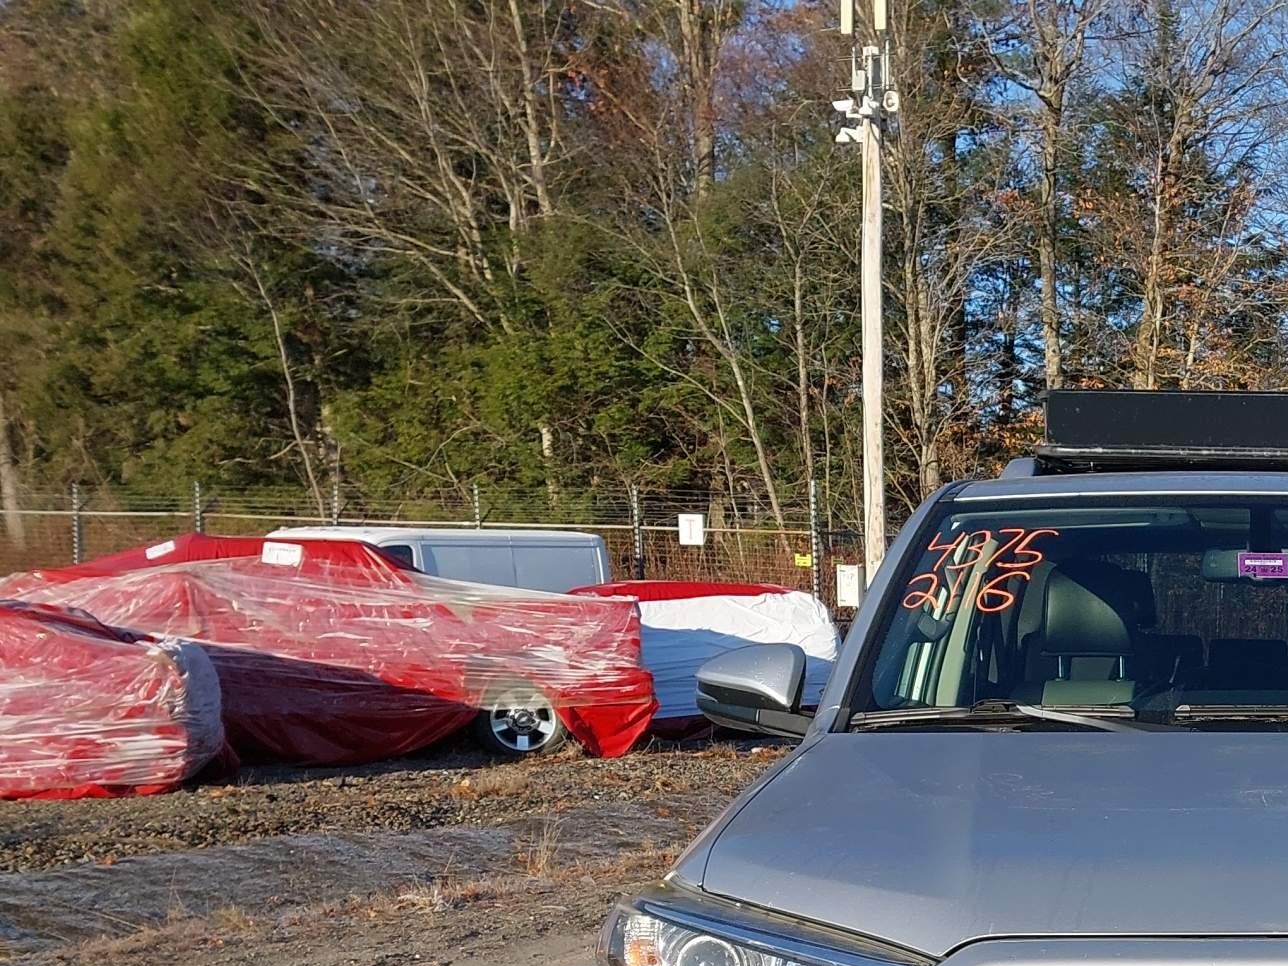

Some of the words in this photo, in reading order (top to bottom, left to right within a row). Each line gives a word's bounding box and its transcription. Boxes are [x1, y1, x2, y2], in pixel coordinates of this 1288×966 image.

[928, 528, 1059, 571] 4375
[1244, 565, 1257, 573] 24
[1270, 565, 1284, 574] 25
[903, 571, 1030, 612] 2116
